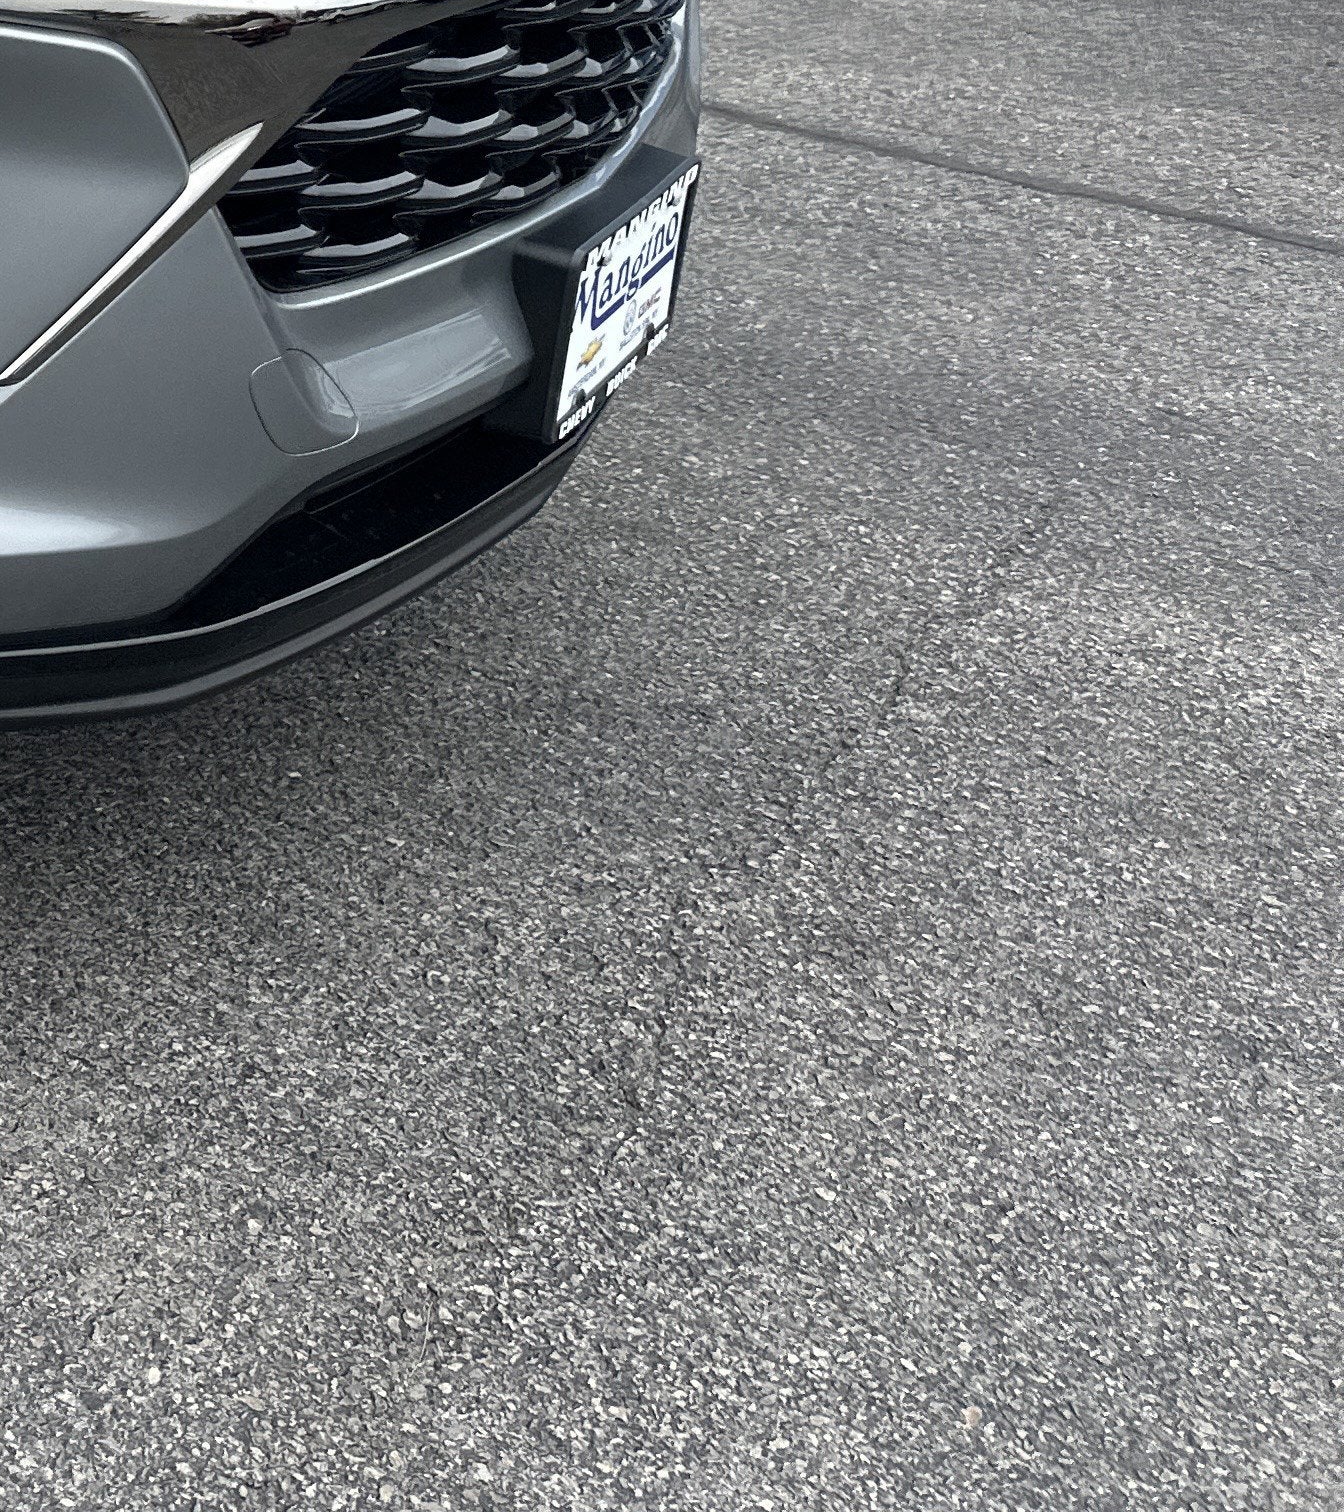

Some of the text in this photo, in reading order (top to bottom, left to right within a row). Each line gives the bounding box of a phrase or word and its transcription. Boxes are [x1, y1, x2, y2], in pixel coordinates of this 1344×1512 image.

[576, 212, 678, 330] Mangino
[559, 396, 595, 439] CHEVY
[606, 356, 637, 396] BUICK
